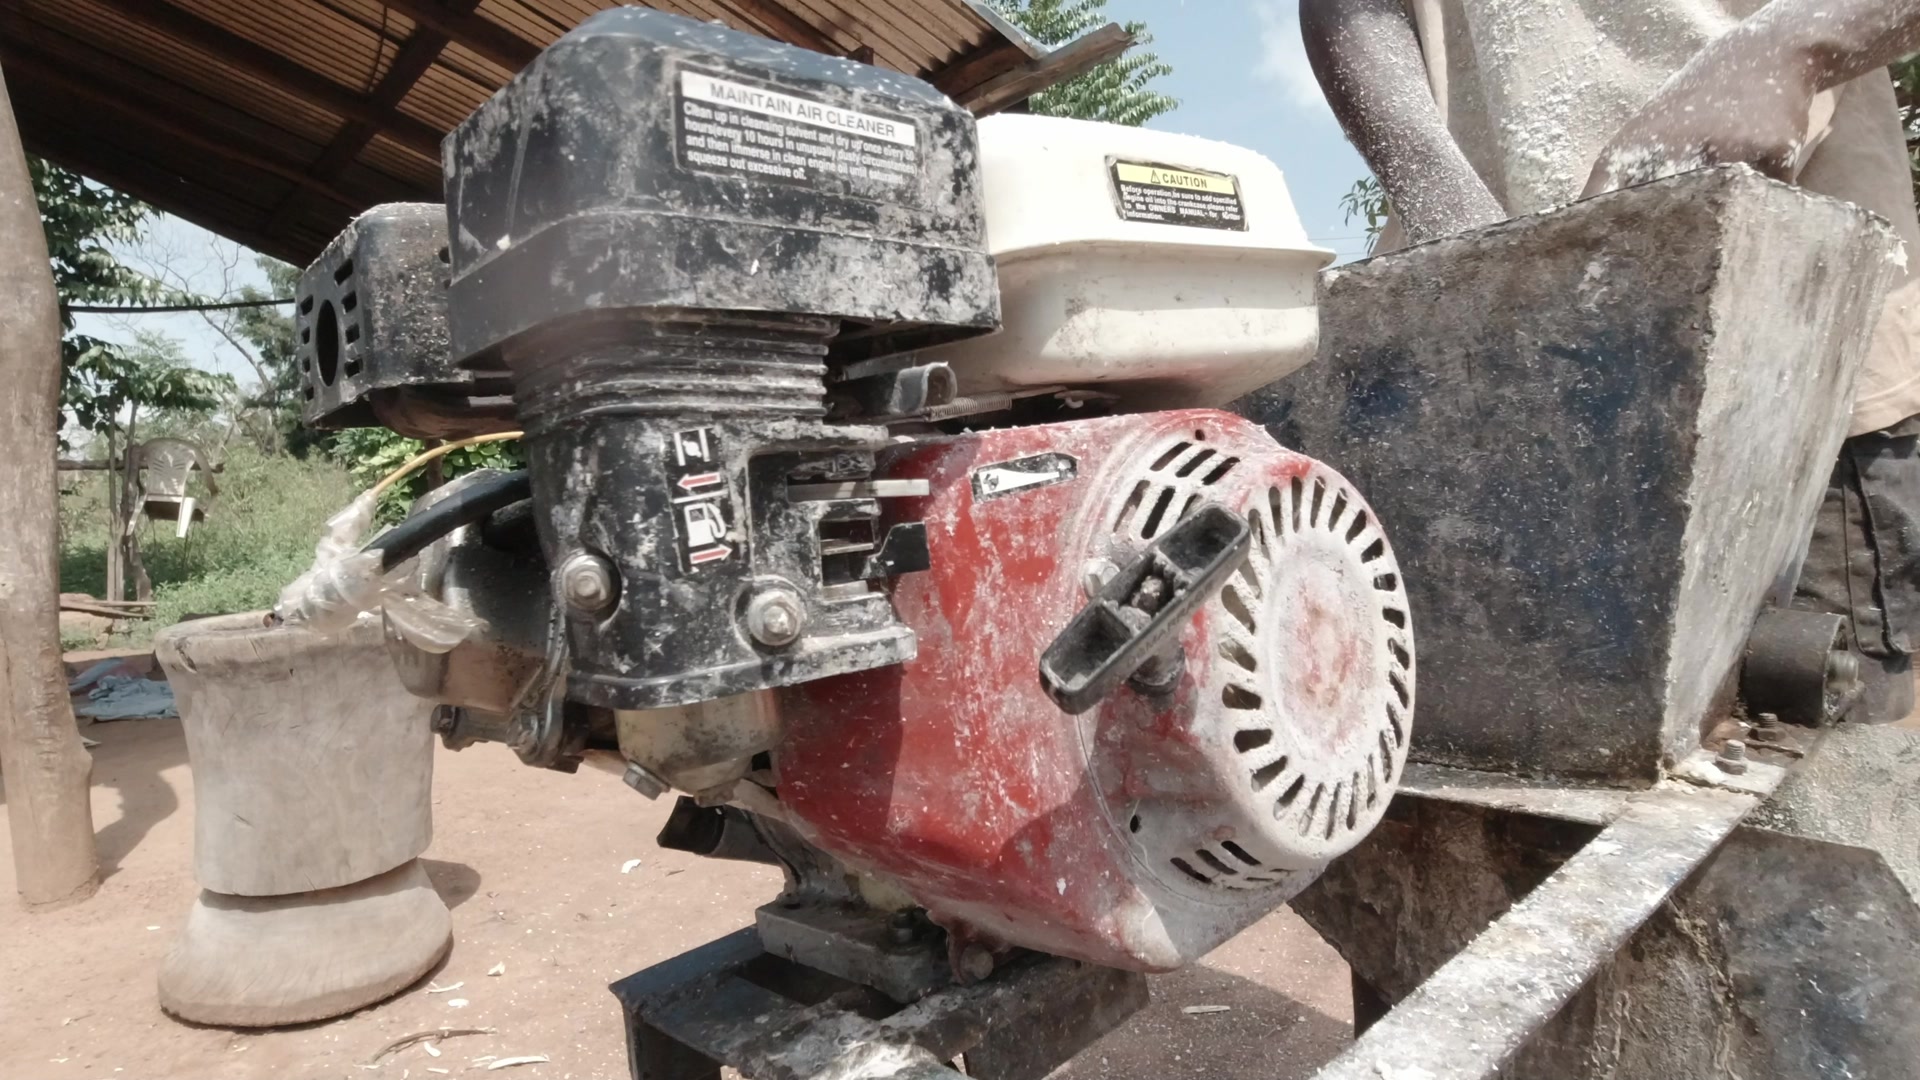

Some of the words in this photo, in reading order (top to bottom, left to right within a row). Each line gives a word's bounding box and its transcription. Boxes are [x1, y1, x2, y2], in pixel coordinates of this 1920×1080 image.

[710, 82, 793, 114] MAINTAIN
[797, 103, 822, 121] AIR
[826, 110, 896, 137] CLEANER
[684, 101, 713, 119] Clean
[714, 111, 727, 125] up
[729, 111, 739, 125] in
[741, 115, 784, 136] cleansing
[786, 125, 817, 141] solvent
[819, 132, 834, 145] and
[836, 136, 850, 150] dry
[851, 140, 863, 152] up
[863, 143, 882, 155] once
[744, 130, 755, 143] 10
[757, 131, 784, 148] hours
[785, 137, 794, 151] in
[686, 135, 705, 148] and
[707, 136, 729, 152] then
[731, 141, 770, 160] immerse
[772, 149, 781, 161] in
[783, 152, 806, 166] clean
[807, 158, 836, 172] engine
[838, 161, 848, 174] oil
[849, 165, 867, 178] until
[687, 150, 728, 167] squeeze
[729, 158, 746, 170] out
[747, 160, 791, 177] excessive
[1162, 173, 1207, 188] CAUTION
[1135, 203, 1146, 211] the
[1145, 195, 1154, 203] oil
[1154, 196, 1167, 205] into
[1167, 198, 1177, 206] the
[1194, 193, 1201, 201] to
